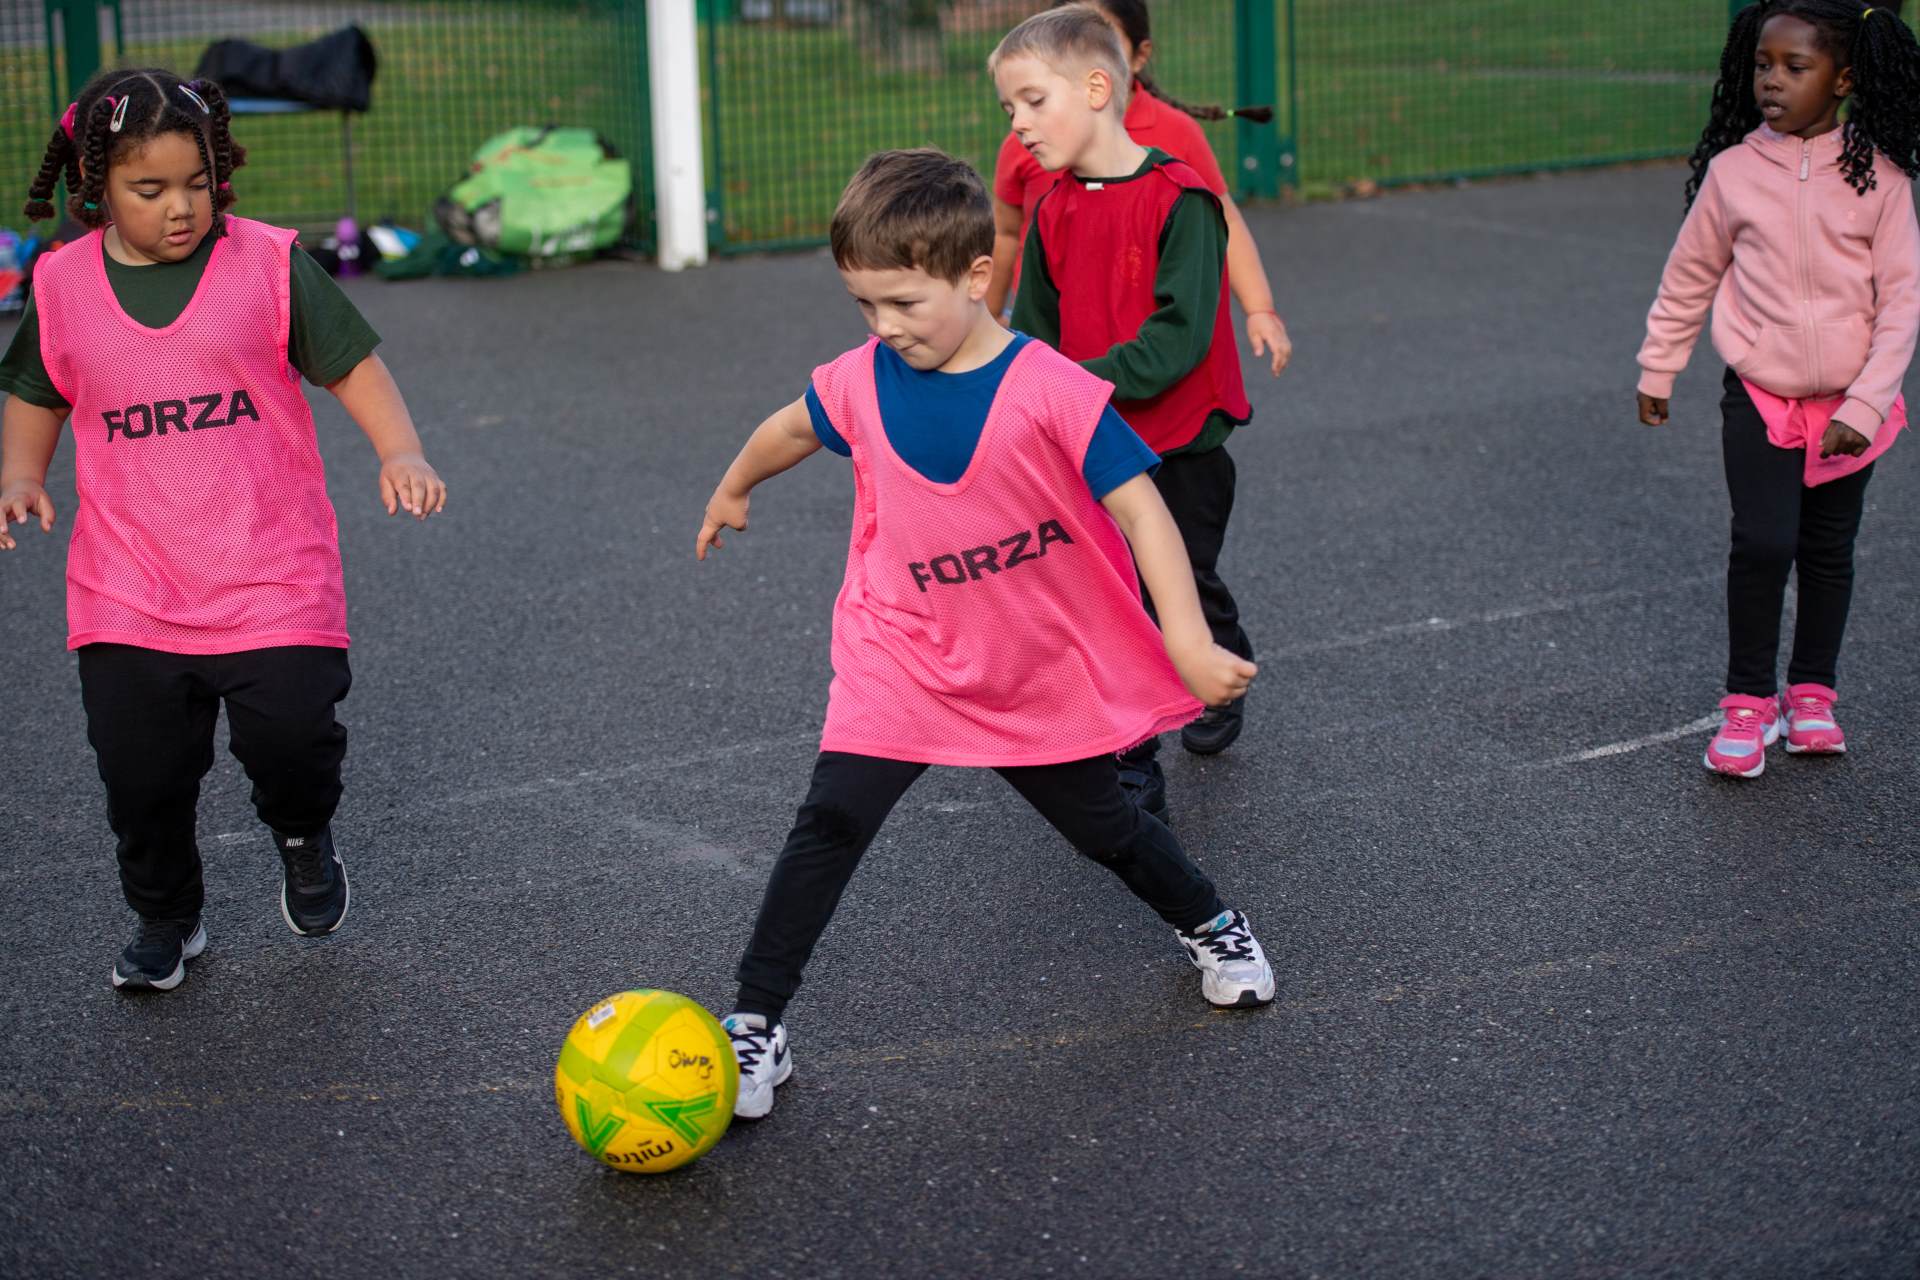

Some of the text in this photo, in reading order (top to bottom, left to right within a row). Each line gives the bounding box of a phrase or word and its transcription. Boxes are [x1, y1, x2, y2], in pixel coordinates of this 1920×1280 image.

[101, 389, 260, 442] FORZA
[908, 519, 1075, 592] FORZA
[286, 837, 305, 847] NIKE
[606, 1140, 673, 1165] mitre
